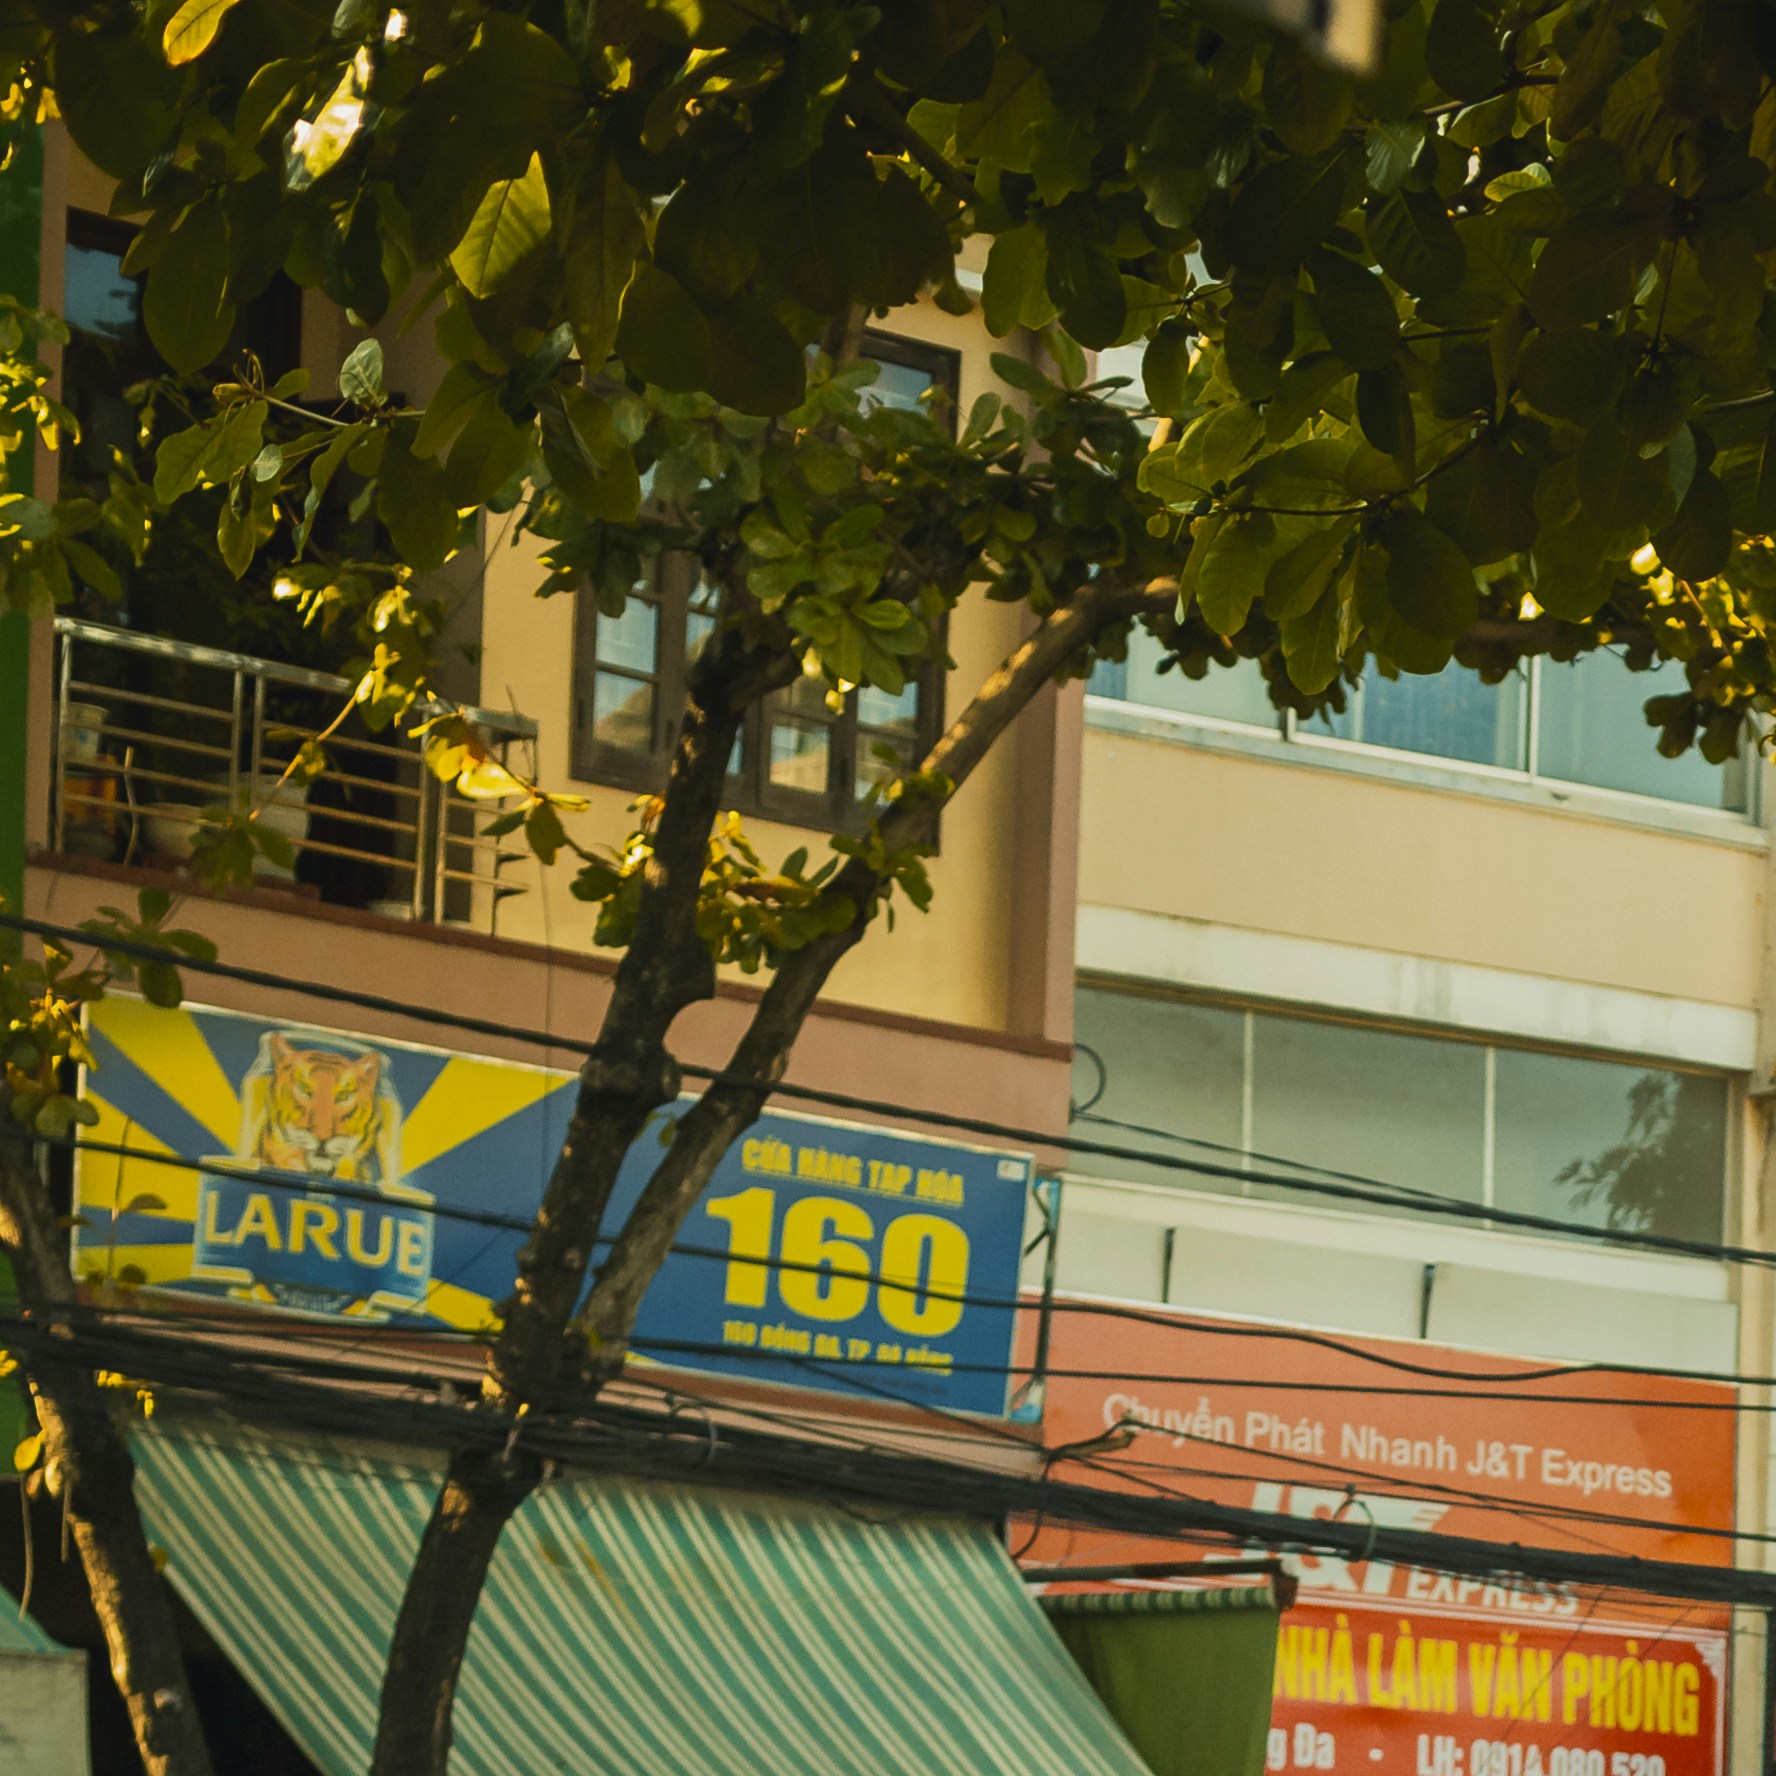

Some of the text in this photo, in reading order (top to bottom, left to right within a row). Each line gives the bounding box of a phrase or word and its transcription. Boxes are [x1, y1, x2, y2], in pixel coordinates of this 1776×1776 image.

[204, 1190, 426, 1277] LARUE
[706, 1187, 970, 1337] 160
[1245, 1411, 1325, 1456] Phát
[1340, 1423, 1458, 1472] Nhanh
[1466, 1440, 1534, 1481] J&T
[1541, 1447, 1674, 1498] Express
[1273, 1613, 1700, 1738] NHÀ LÀM VĂN PHÒNG
